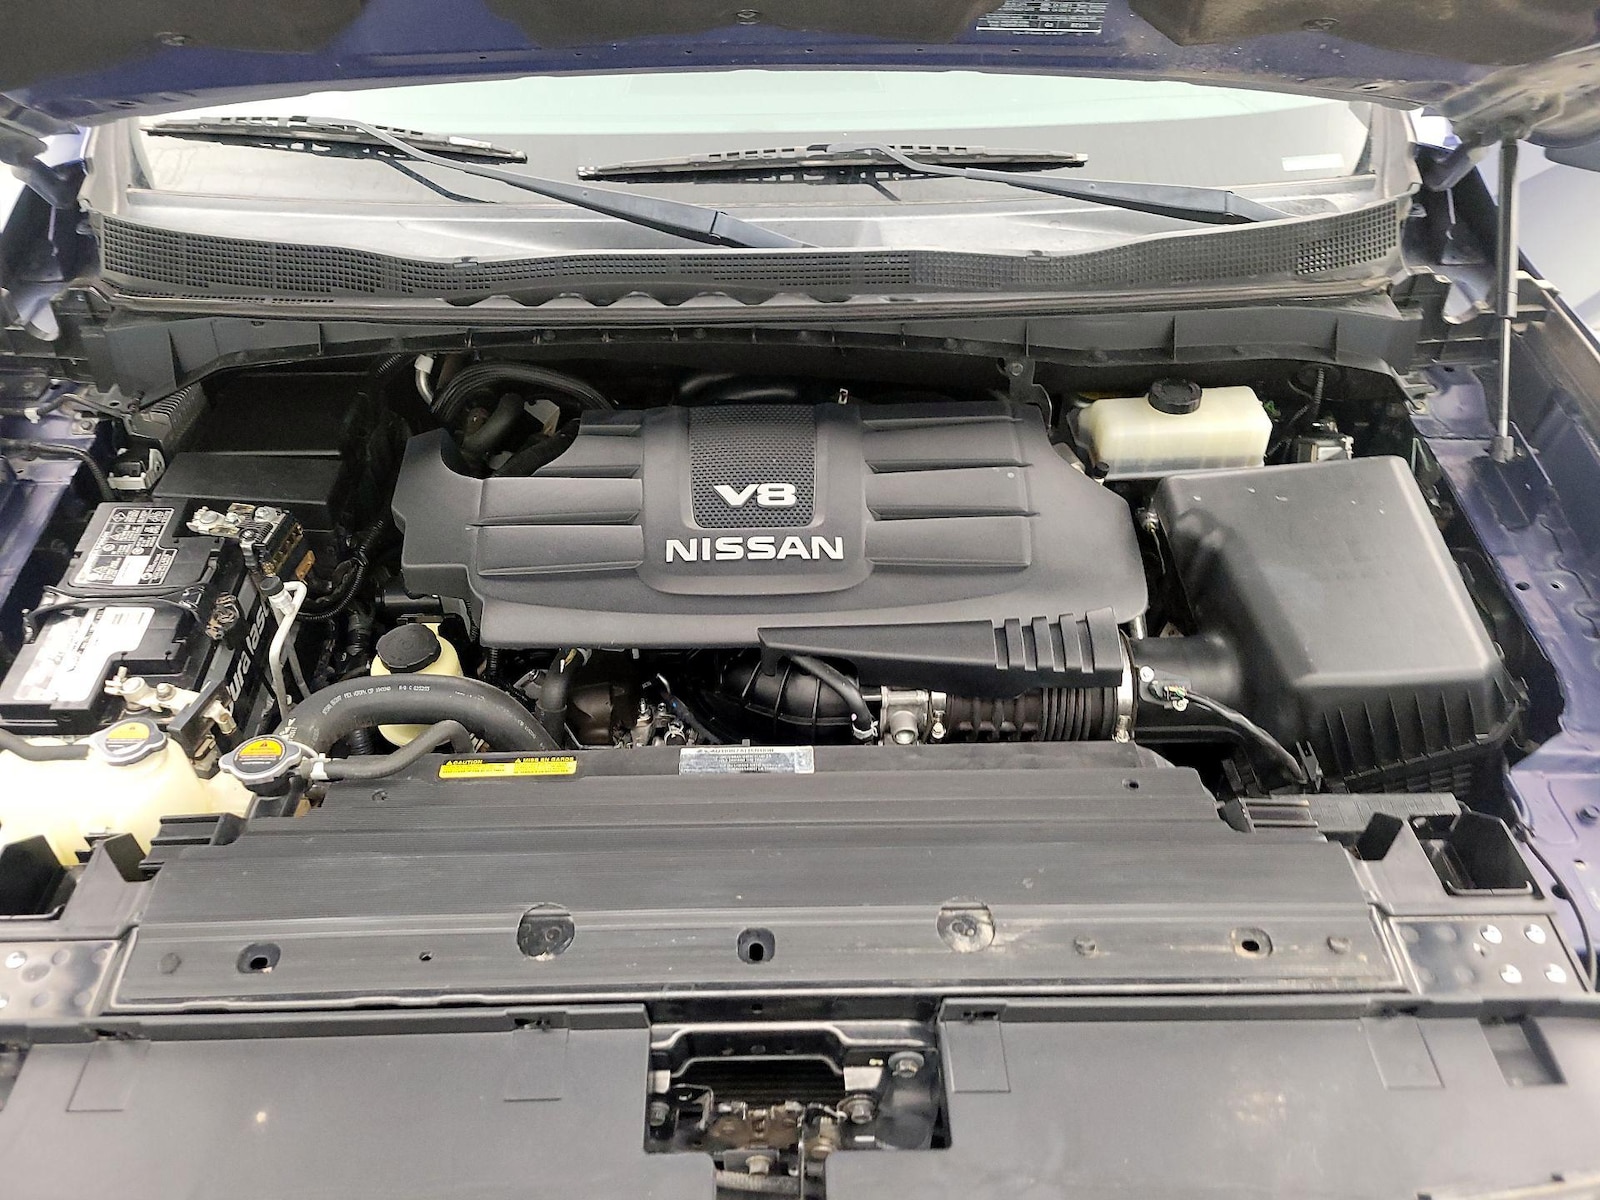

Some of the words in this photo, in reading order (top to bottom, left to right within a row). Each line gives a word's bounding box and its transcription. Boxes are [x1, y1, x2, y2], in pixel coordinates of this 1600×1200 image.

[713, 482, 797, 508] V8
[665, 536, 844, 562] NISSAN
[226, 600, 270, 715] uralast
